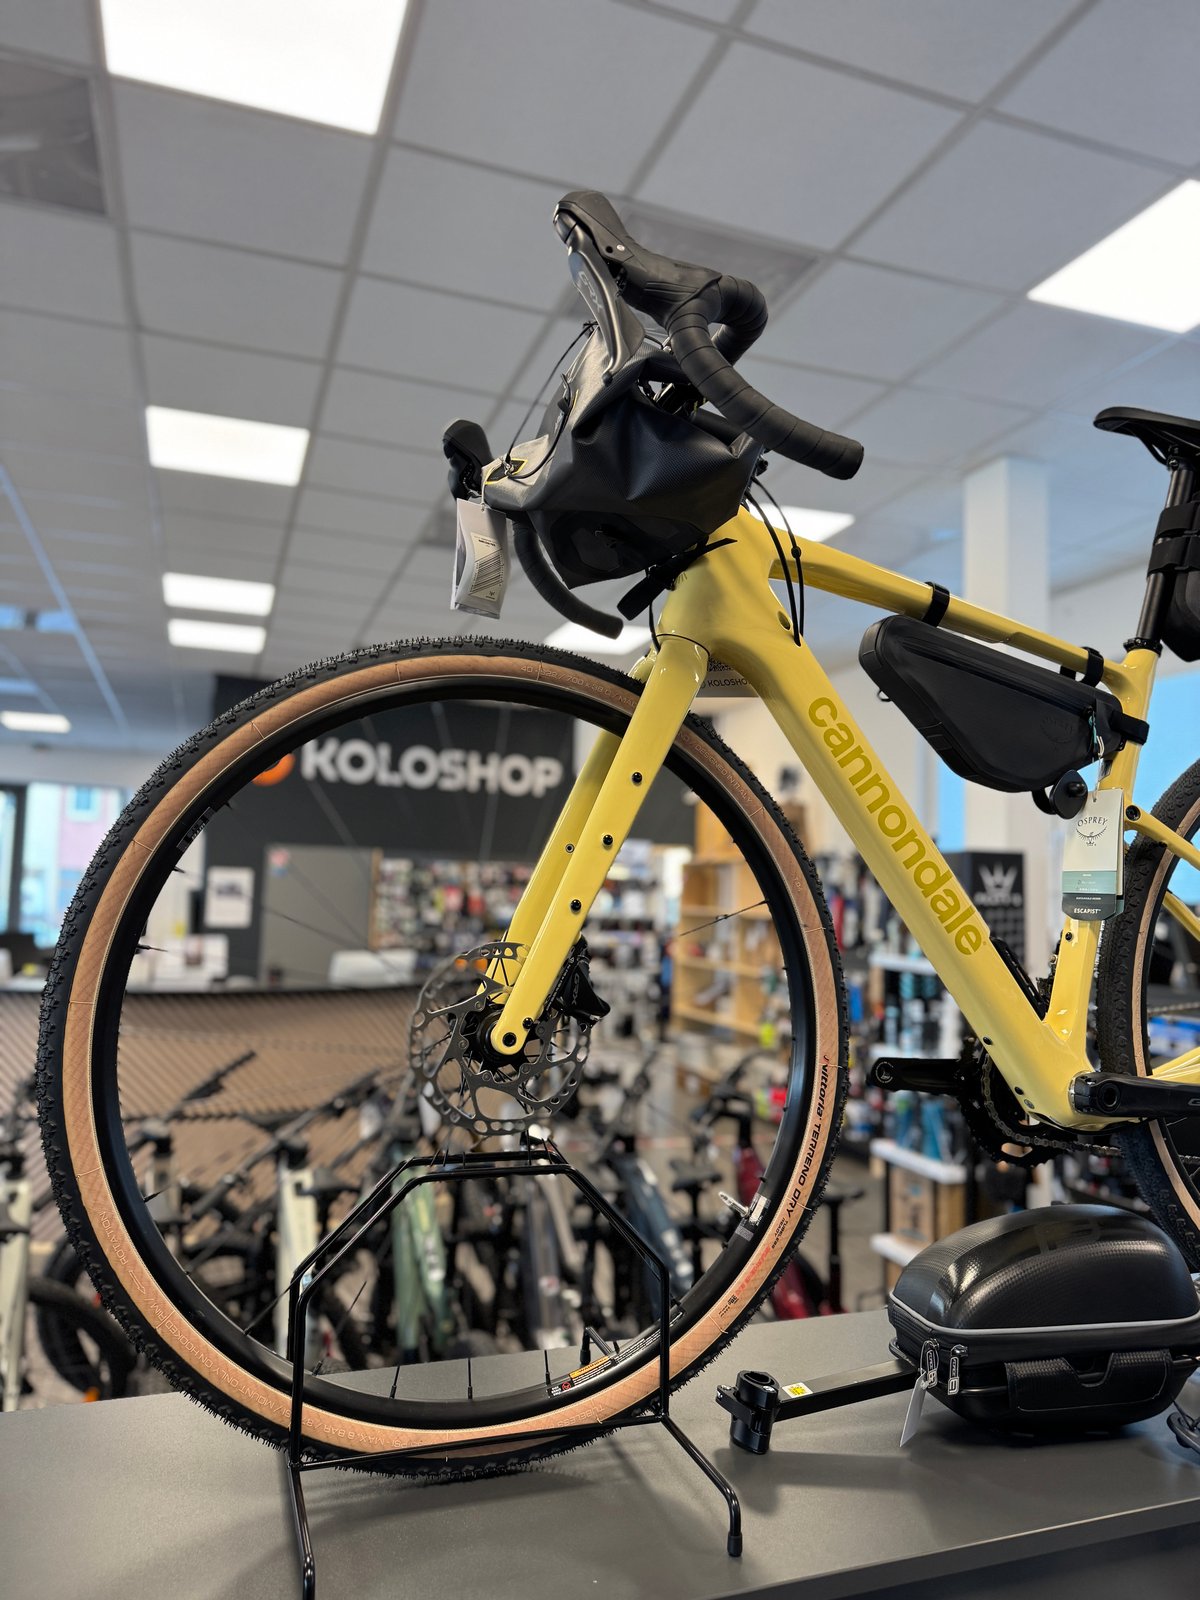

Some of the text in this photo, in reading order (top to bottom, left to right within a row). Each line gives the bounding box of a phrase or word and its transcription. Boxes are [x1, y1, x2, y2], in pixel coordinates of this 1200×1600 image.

[303, 738, 563, 797] KOLOSHOP
[808, 697, 982, 955] cannondale
[1077, 816, 1108, 827] OSPREY
[798, 1123, 821, 1186] TERRENO
[786, 1191, 802, 1219] DRY
[99, 1210, 129, 1266] ROTATION
[164, 1318, 201, 1357] HOOKED
[197, 1353, 214, 1371] ON
[214, 1366, 240, 1388] ONLY
[238, 1380, 274, 1410] MOUNT
[323, 1425, 345, 1438] BAR
